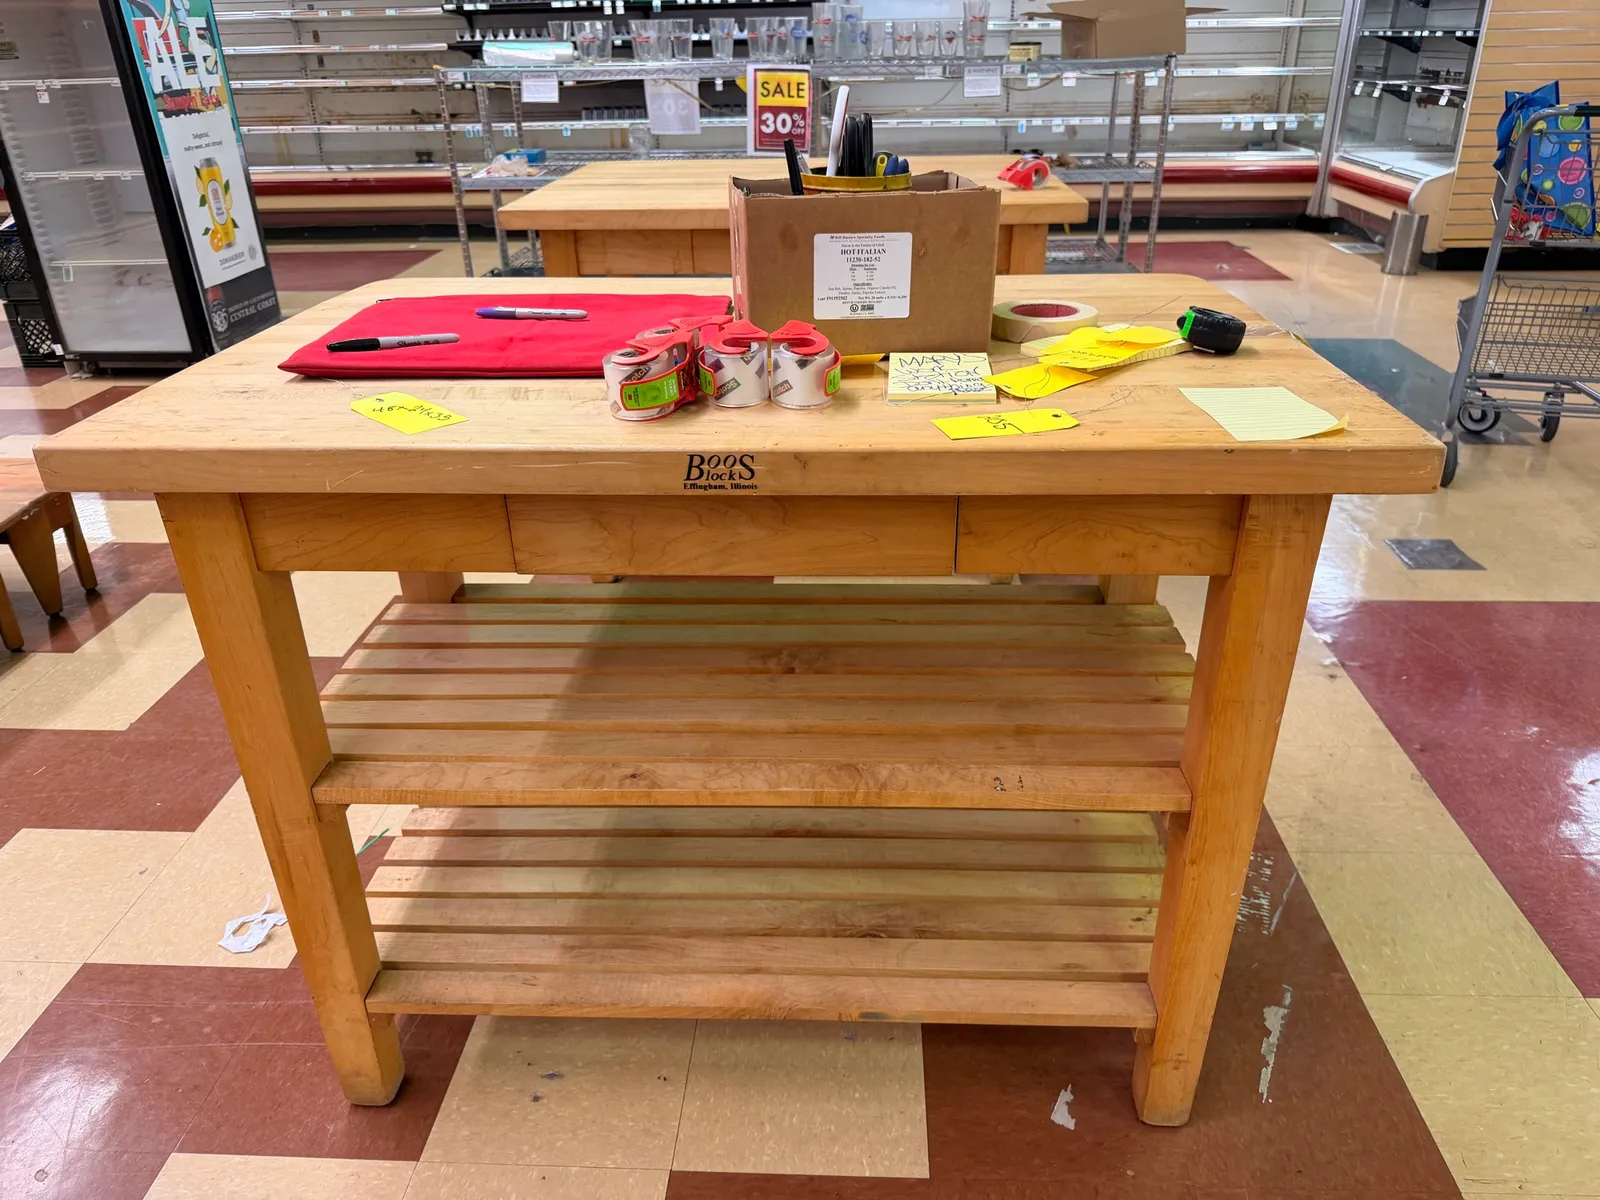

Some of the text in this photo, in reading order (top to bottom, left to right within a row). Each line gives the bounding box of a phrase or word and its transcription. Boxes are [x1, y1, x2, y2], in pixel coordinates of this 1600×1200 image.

[760, 81, 805, 99] SALE
[683, 482, 758, 491] Effingham, Illinois
